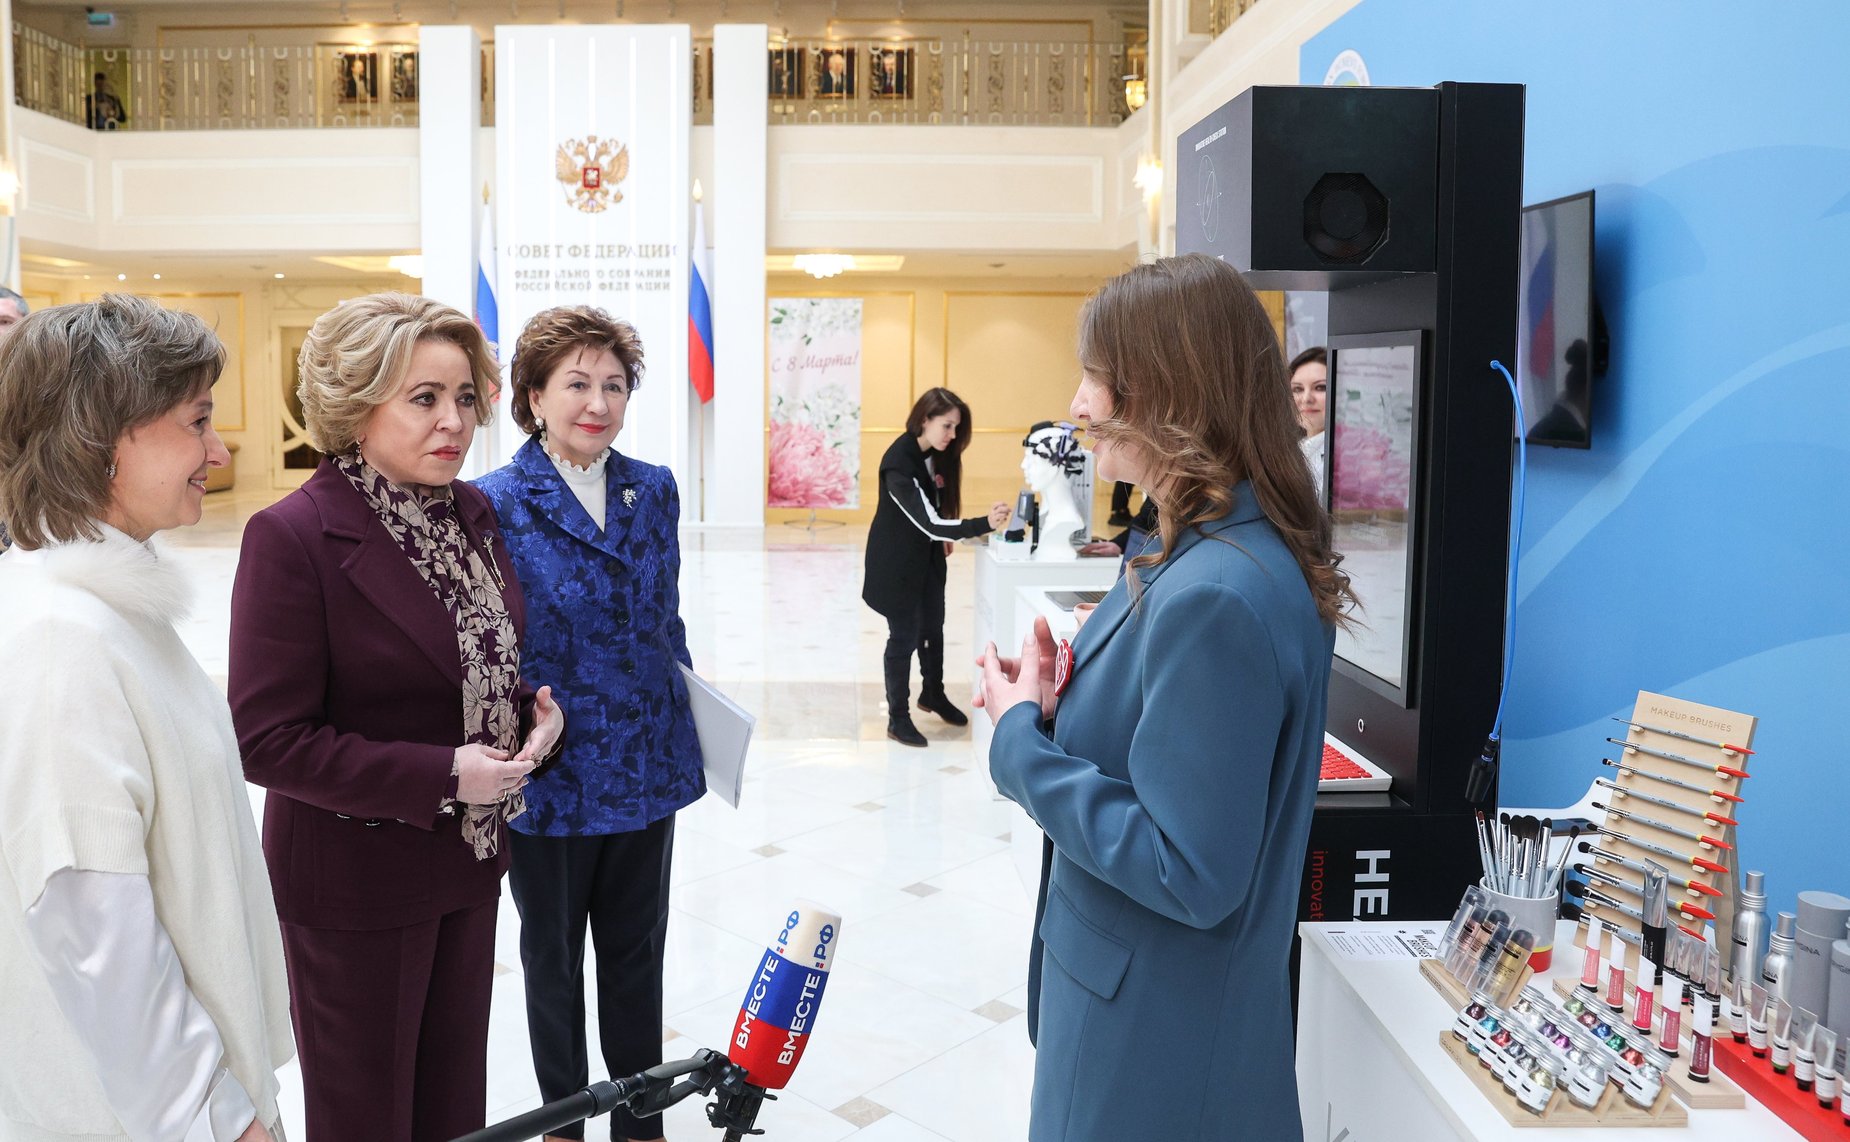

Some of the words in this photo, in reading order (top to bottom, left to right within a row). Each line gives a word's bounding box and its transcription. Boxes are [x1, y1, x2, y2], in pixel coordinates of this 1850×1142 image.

[786, 356, 797, 371] 8
[800, 349, 859, 374] Марта!
[1651, 706, 1687, 721] MAKEUP
[1689, 715, 1733, 733] BRUSHES
[1353, 850, 1391, 922] HE
